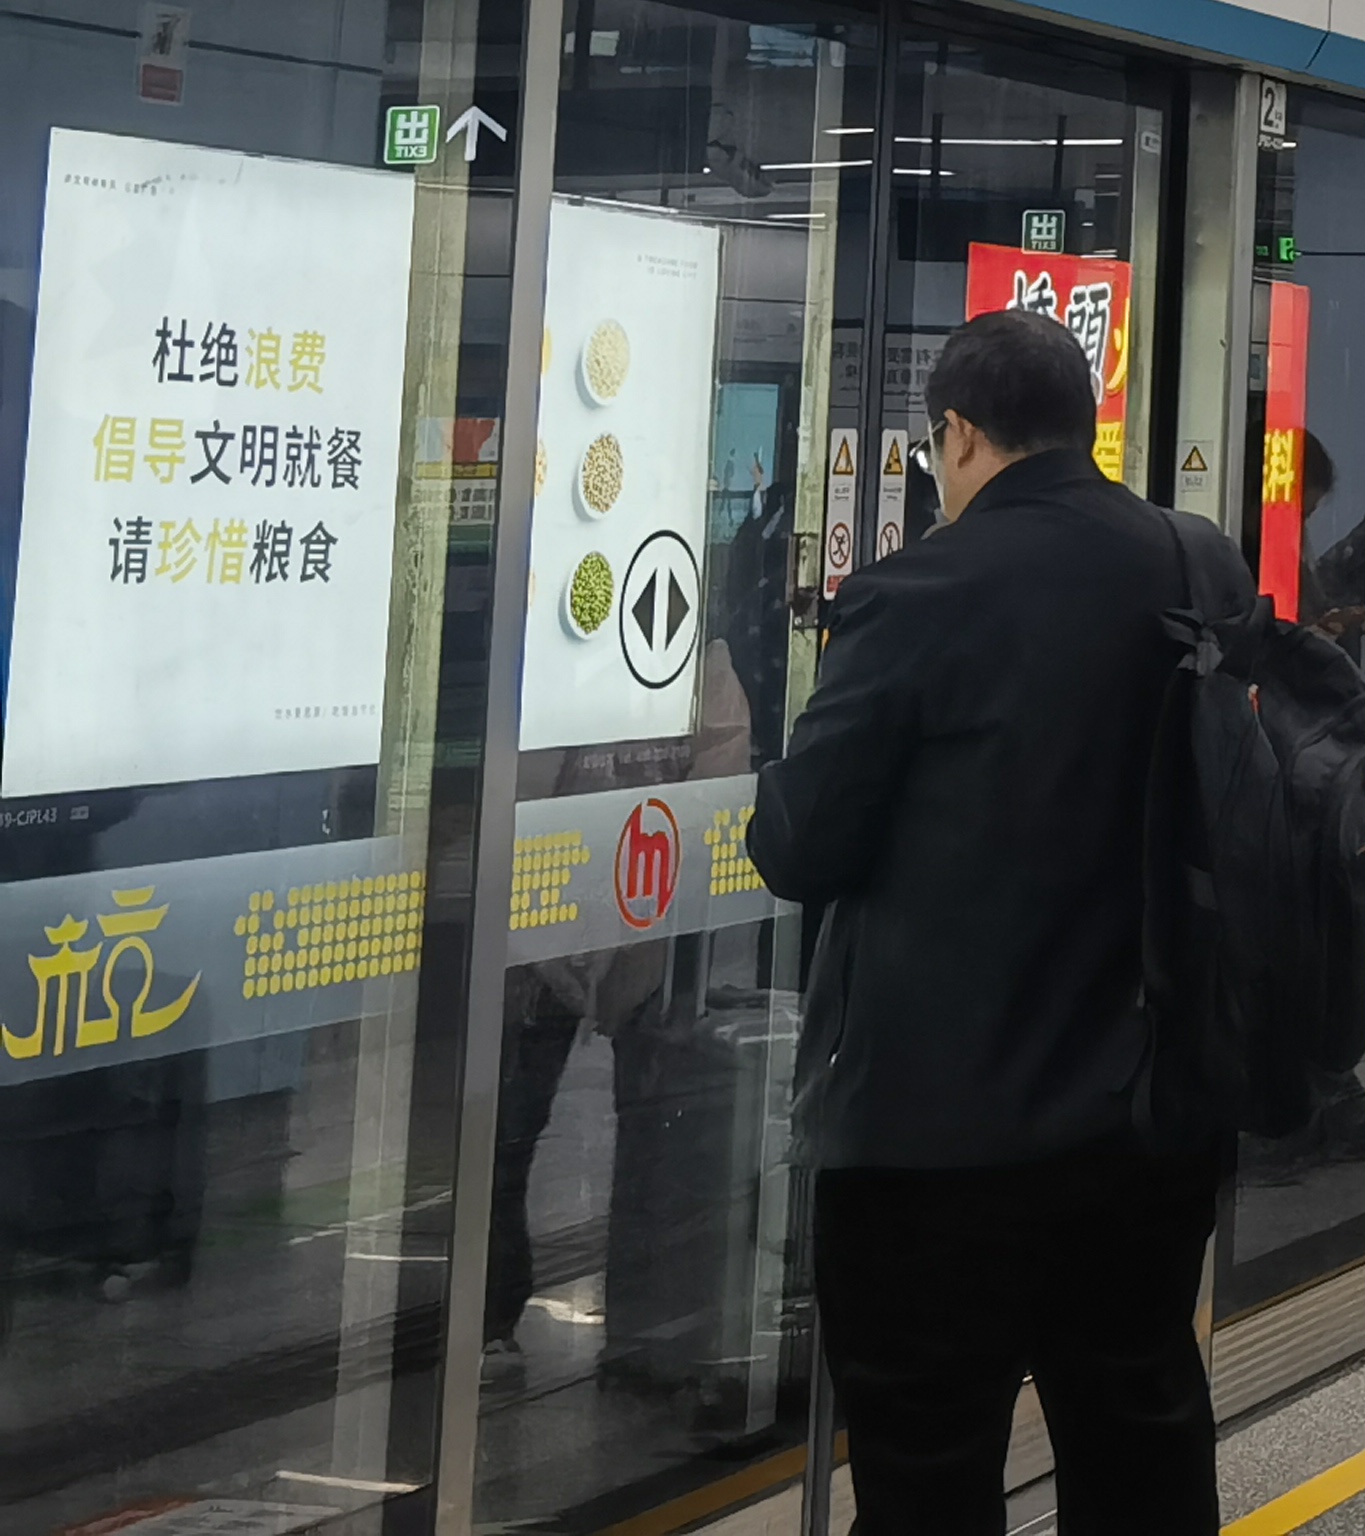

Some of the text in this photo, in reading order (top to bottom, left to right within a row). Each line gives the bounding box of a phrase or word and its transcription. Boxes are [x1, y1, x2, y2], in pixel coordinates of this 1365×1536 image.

[1263, 86, 1277, 127] 2
[152, 316, 327, 395] 杜绝浪费
[92, 412, 362, 491] 倡导文明就餐
[107, 516, 338, 586] 请珍惜粮食
